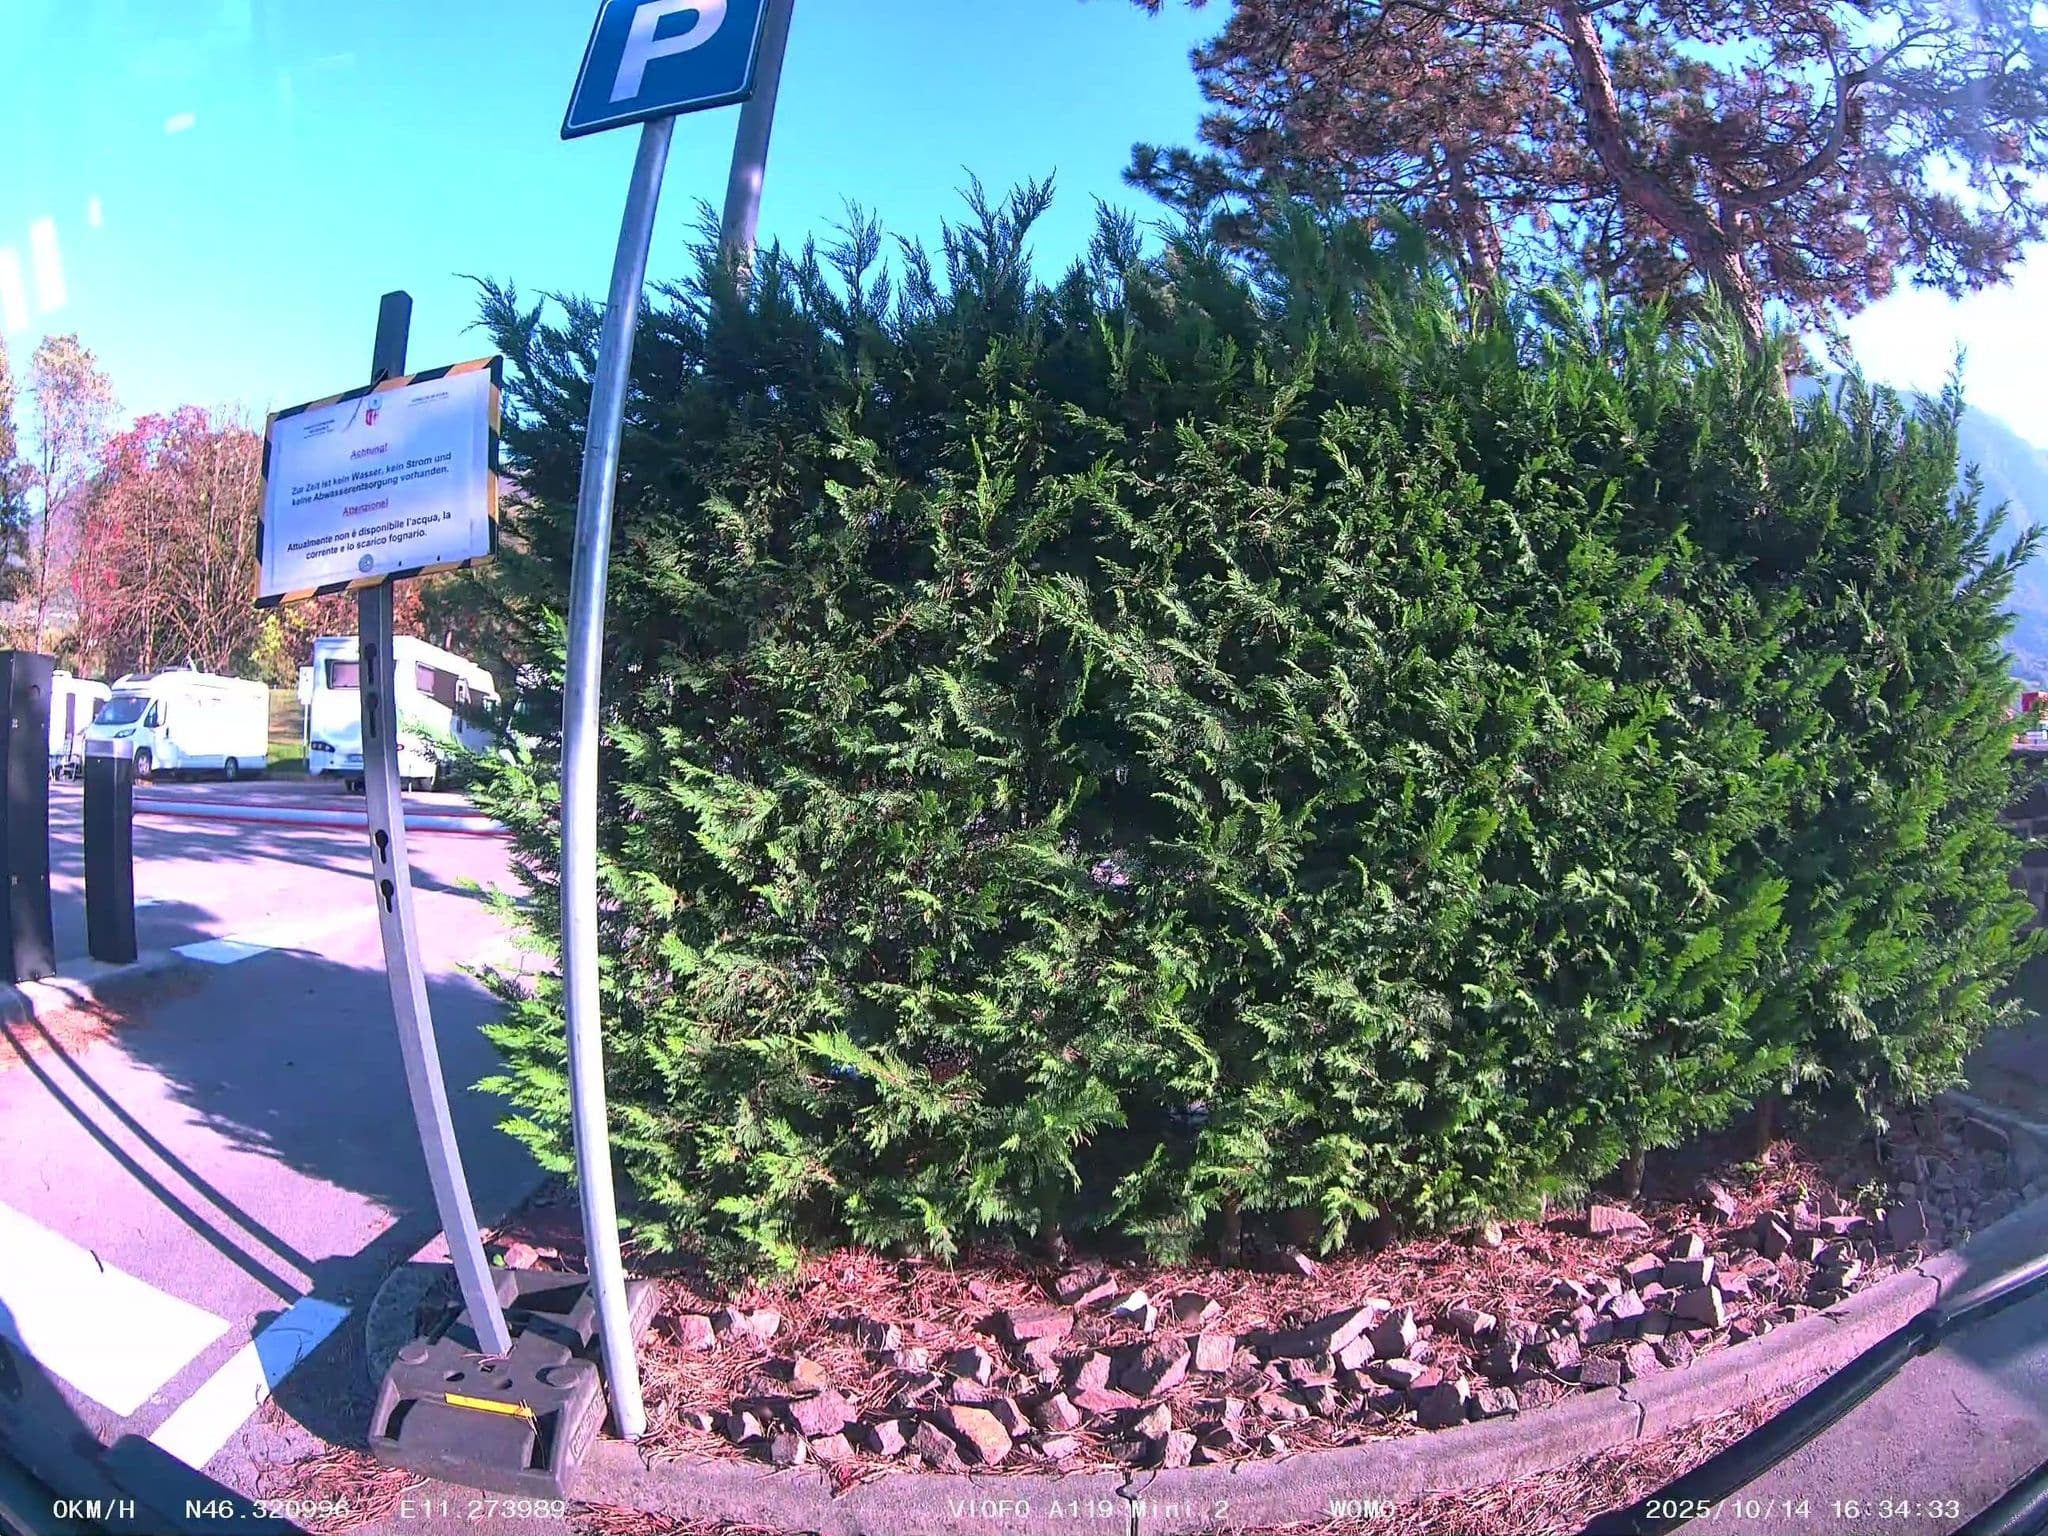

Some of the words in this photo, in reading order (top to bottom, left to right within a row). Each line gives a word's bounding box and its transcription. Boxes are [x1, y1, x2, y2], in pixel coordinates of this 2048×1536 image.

[609, 0, 727, 103] P
[350, 443, 388, 460] Achtung!
[292, 487, 304, 495] Zur
[306, 483, 320, 492] Zeit
[321, 480, 332, 488] ist
[333, 476, 350, 485] kein
[386, 464, 404, 473] kein
[406, 457, 432, 469] Strom
[434, 452, 452, 462] und
[292, 496, 312, 506] keine
[313, 476, 399, 501] Abwasserentsorgung
[400, 466, 449, 482] vorhanden.
[343, 498, 389, 517] Attenzione!
[287, 536, 333, 552] Attualmente
[334, 532, 350, 541] non
[358, 520, 404, 536] disponibile
[442, 510, 451, 519] la
[306, 546, 338, 560] corrente
[347, 542, 355, 551] lo
[356, 536, 387, 549] scarico
[389, 529, 427, 543] fognario.
